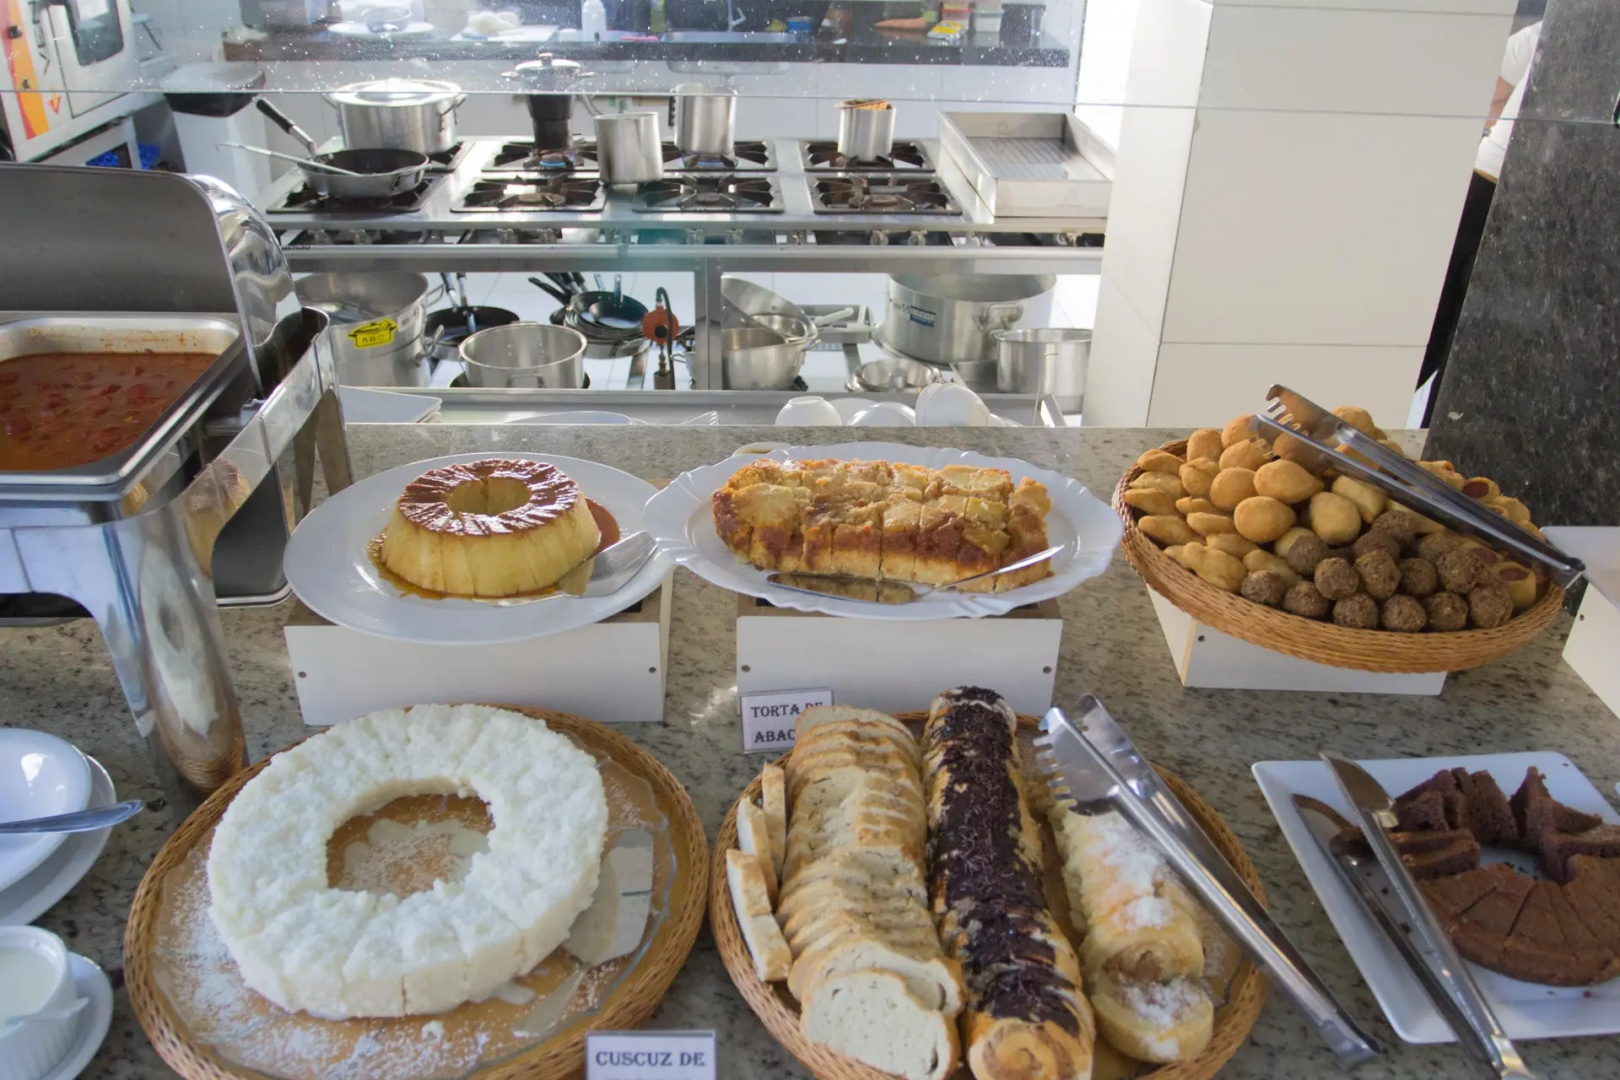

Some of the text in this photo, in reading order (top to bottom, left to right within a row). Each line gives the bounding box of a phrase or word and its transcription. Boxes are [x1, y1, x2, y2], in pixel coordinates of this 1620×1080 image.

[750, 703, 800, 718] TORTA
[595, 1051, 706, 1067] CUSCUZ DE
